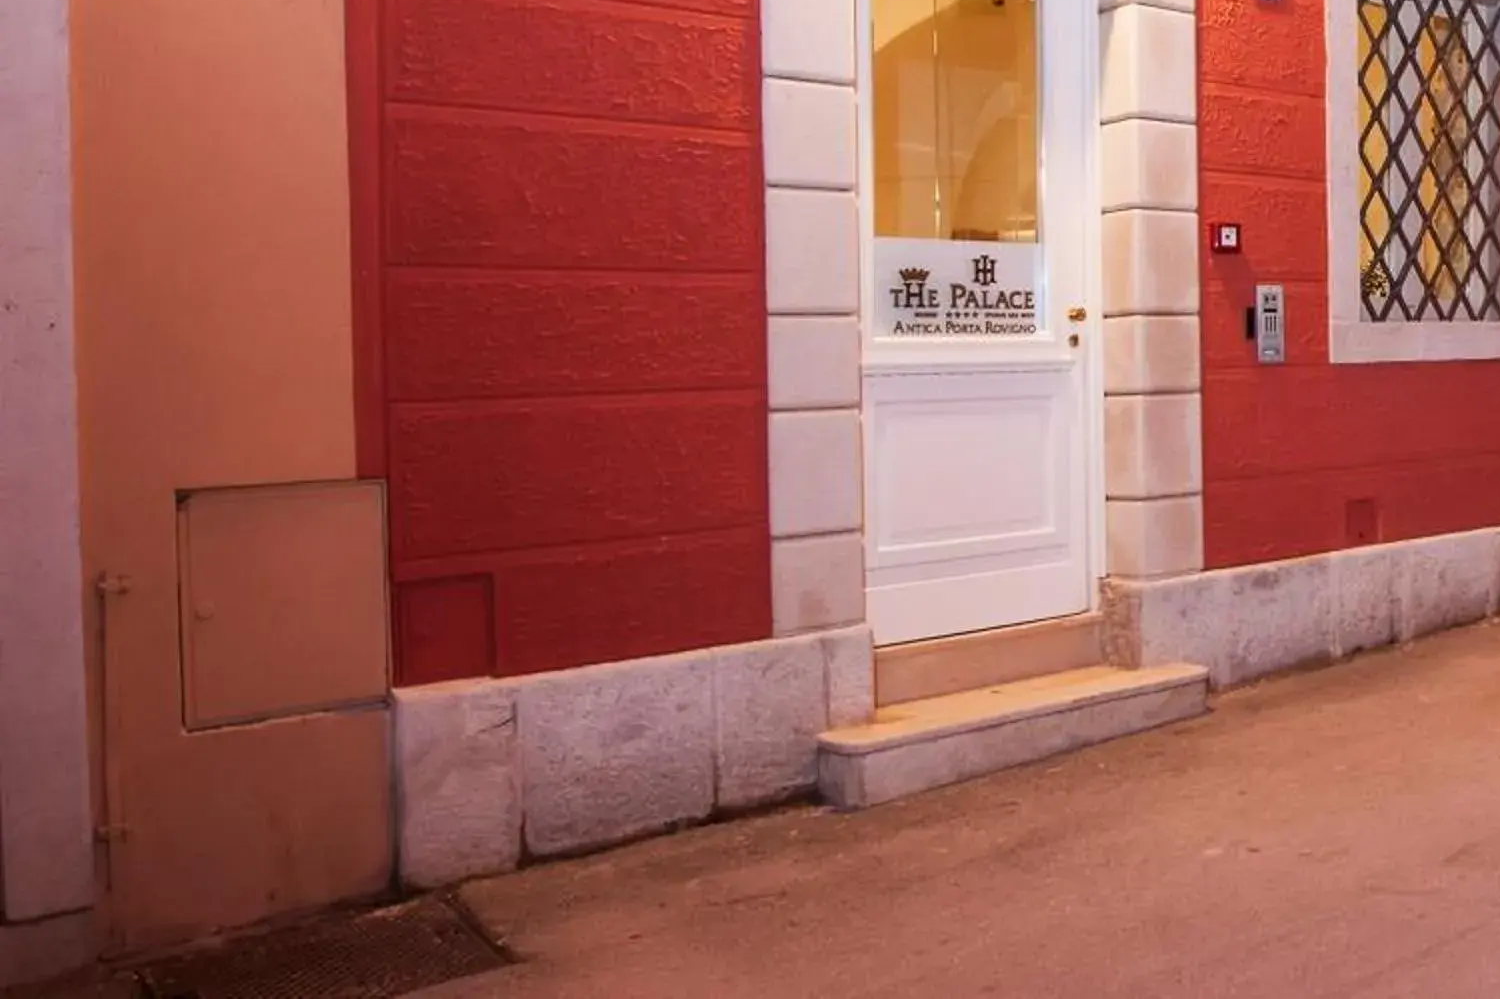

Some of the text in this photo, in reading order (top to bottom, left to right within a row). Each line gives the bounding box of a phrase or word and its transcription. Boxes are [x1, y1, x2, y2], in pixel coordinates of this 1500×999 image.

[889, 282, 1035, 309] THE PALACE
[893, 319, 1037, 334] ANTICA PORTA ROVIGNO
